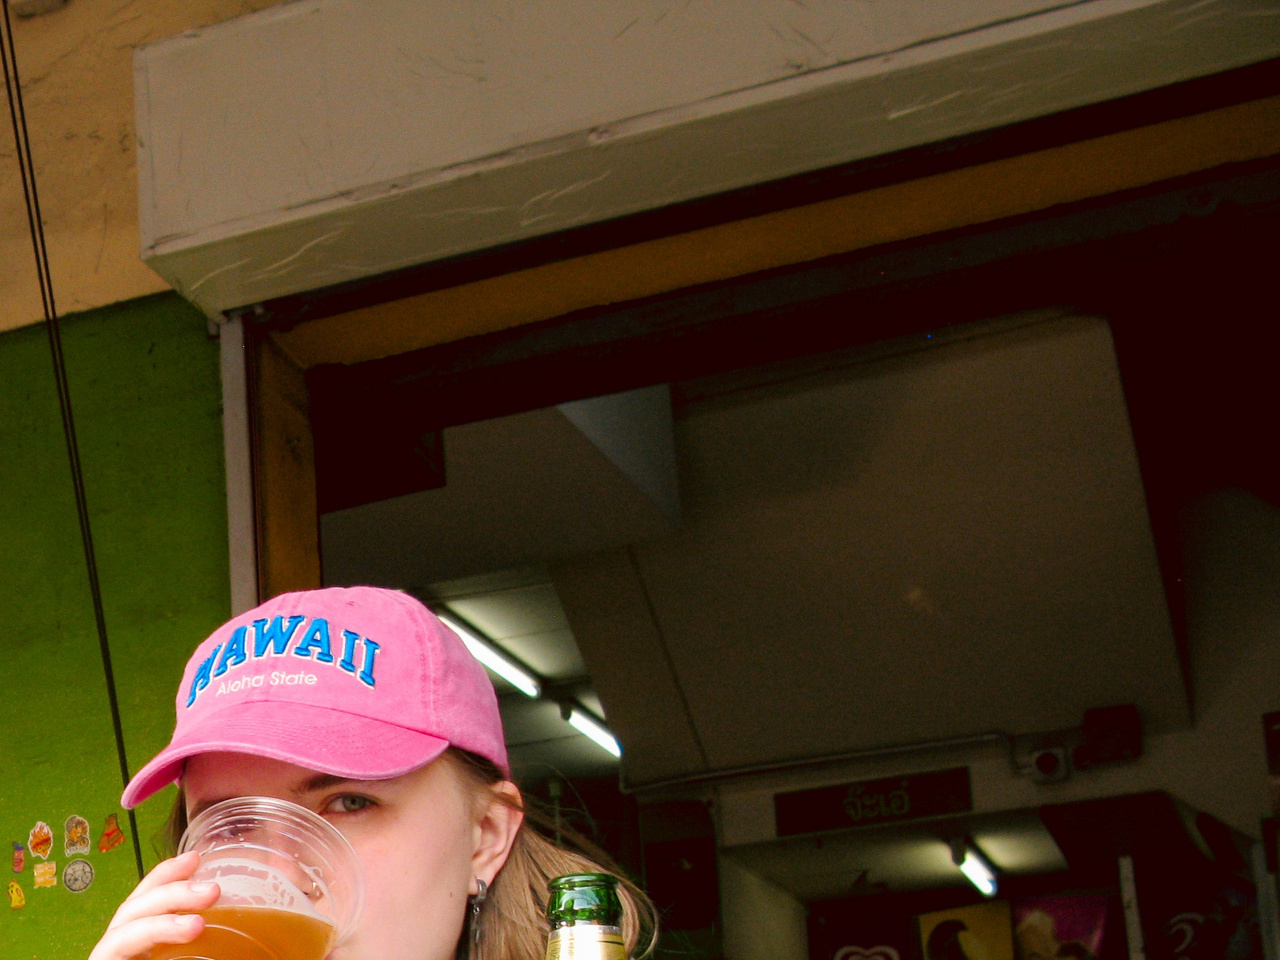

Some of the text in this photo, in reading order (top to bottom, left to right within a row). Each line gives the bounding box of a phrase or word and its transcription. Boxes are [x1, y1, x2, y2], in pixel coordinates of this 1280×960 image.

[186, 615, 382, 708] HAWAII
[216, 670, 318, 697] Aloha State
